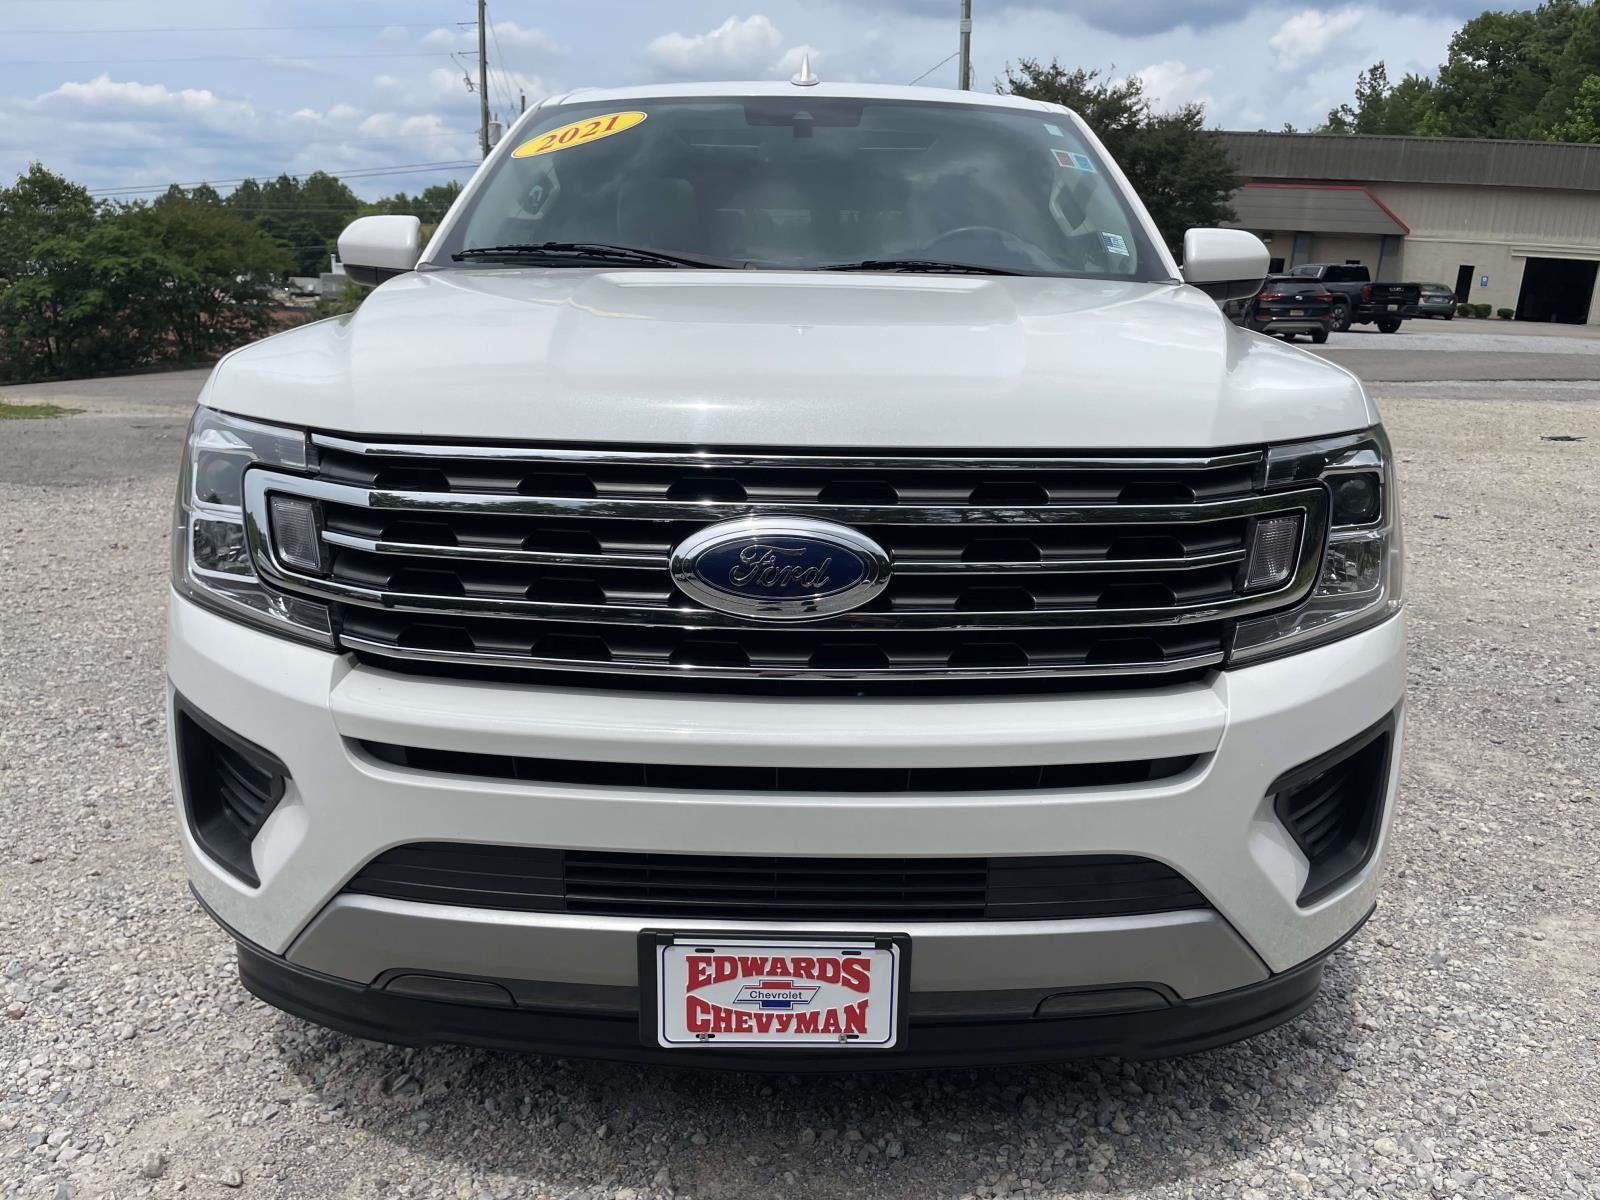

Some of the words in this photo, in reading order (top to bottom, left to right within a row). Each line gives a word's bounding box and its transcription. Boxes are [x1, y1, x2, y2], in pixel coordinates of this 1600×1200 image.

[536, 115, 619, 152] 2021
[729, 545, 832, 588] Ford
[686, 955, 871, 993] EDWARDS
[749, 990, 802, 999] Chevrolet
[686, 994, 869, 1034] CHEVYMAN
